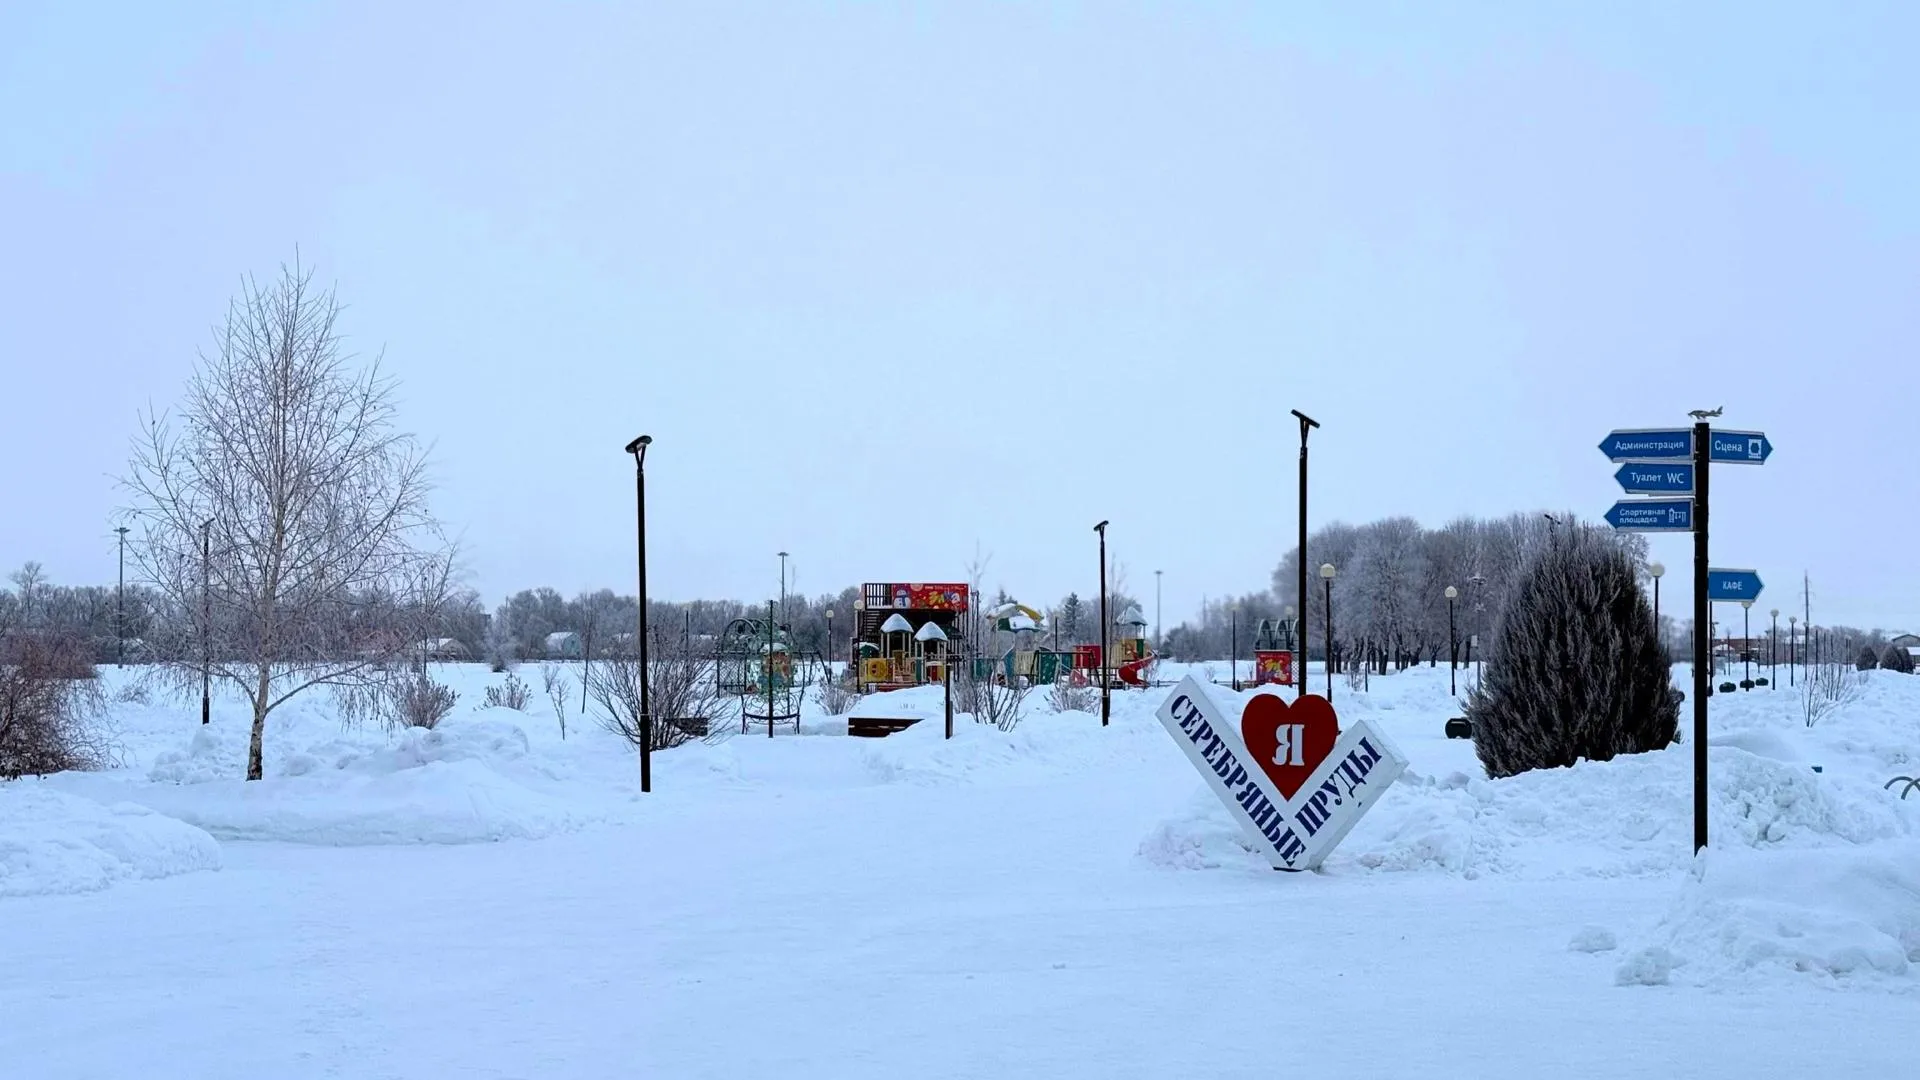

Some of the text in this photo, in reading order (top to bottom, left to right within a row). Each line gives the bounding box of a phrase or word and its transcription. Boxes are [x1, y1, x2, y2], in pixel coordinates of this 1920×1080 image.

[1615, 440, 1684, 450] Администрация
[1714, 440, 1743, 452] Сцена
[1630, 472, 1685, 484] Туалет WC
[1619, 508, 1666, 516] Спортивная
[1619, 516, 1658, 524] площадка
[1722, 580, 1743, 591] КАФЕ
[1272, 724, 1305, 766] Я
[1171, 694, 1306, 867] СЕРЕБРЯНЫЕ
[1294, 736, 1383, 837] ПРУДЫ
